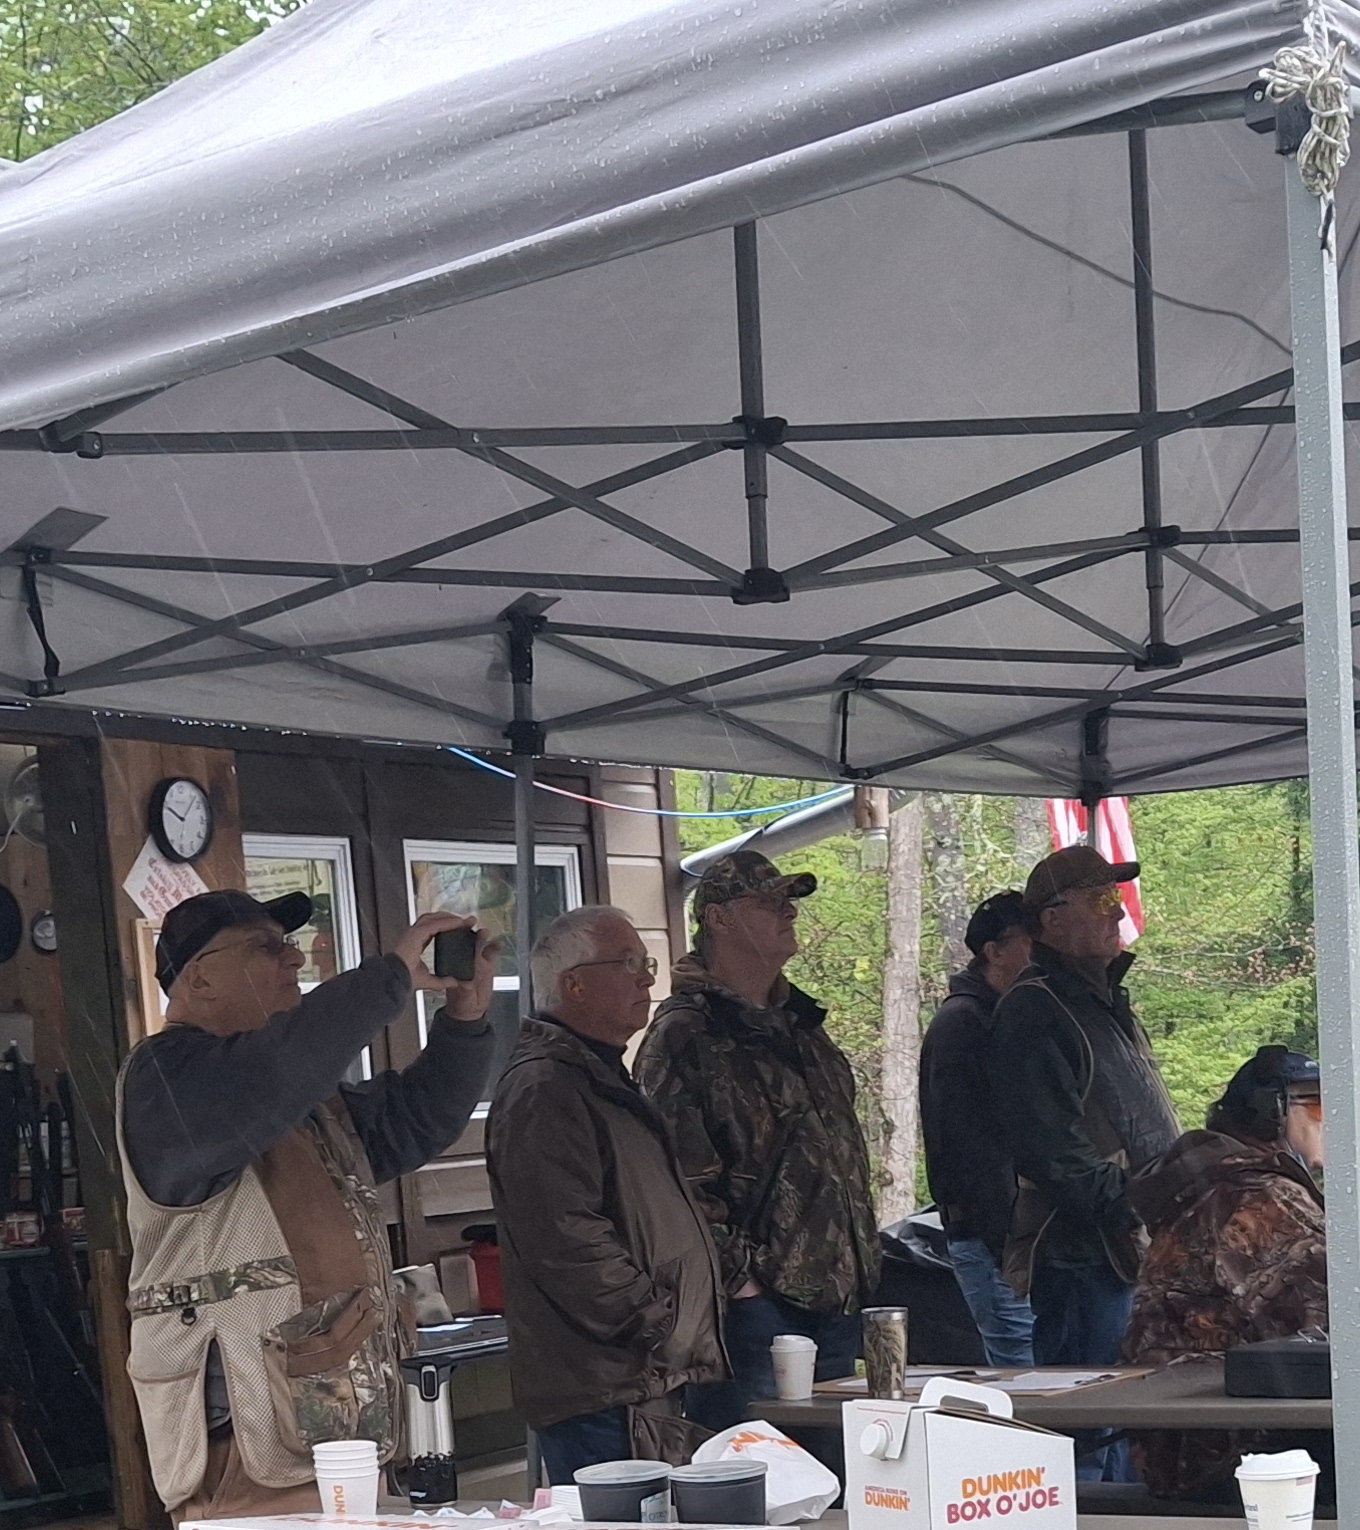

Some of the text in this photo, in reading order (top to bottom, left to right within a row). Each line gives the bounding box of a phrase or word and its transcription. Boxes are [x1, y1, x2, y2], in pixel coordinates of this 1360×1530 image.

[962, 1466, 1046, 1499] DUNKIN'
[865, 1491, 910, 1511] DUNKIN'
[947, 1486, 1059, 1524] BOX O'JOE
